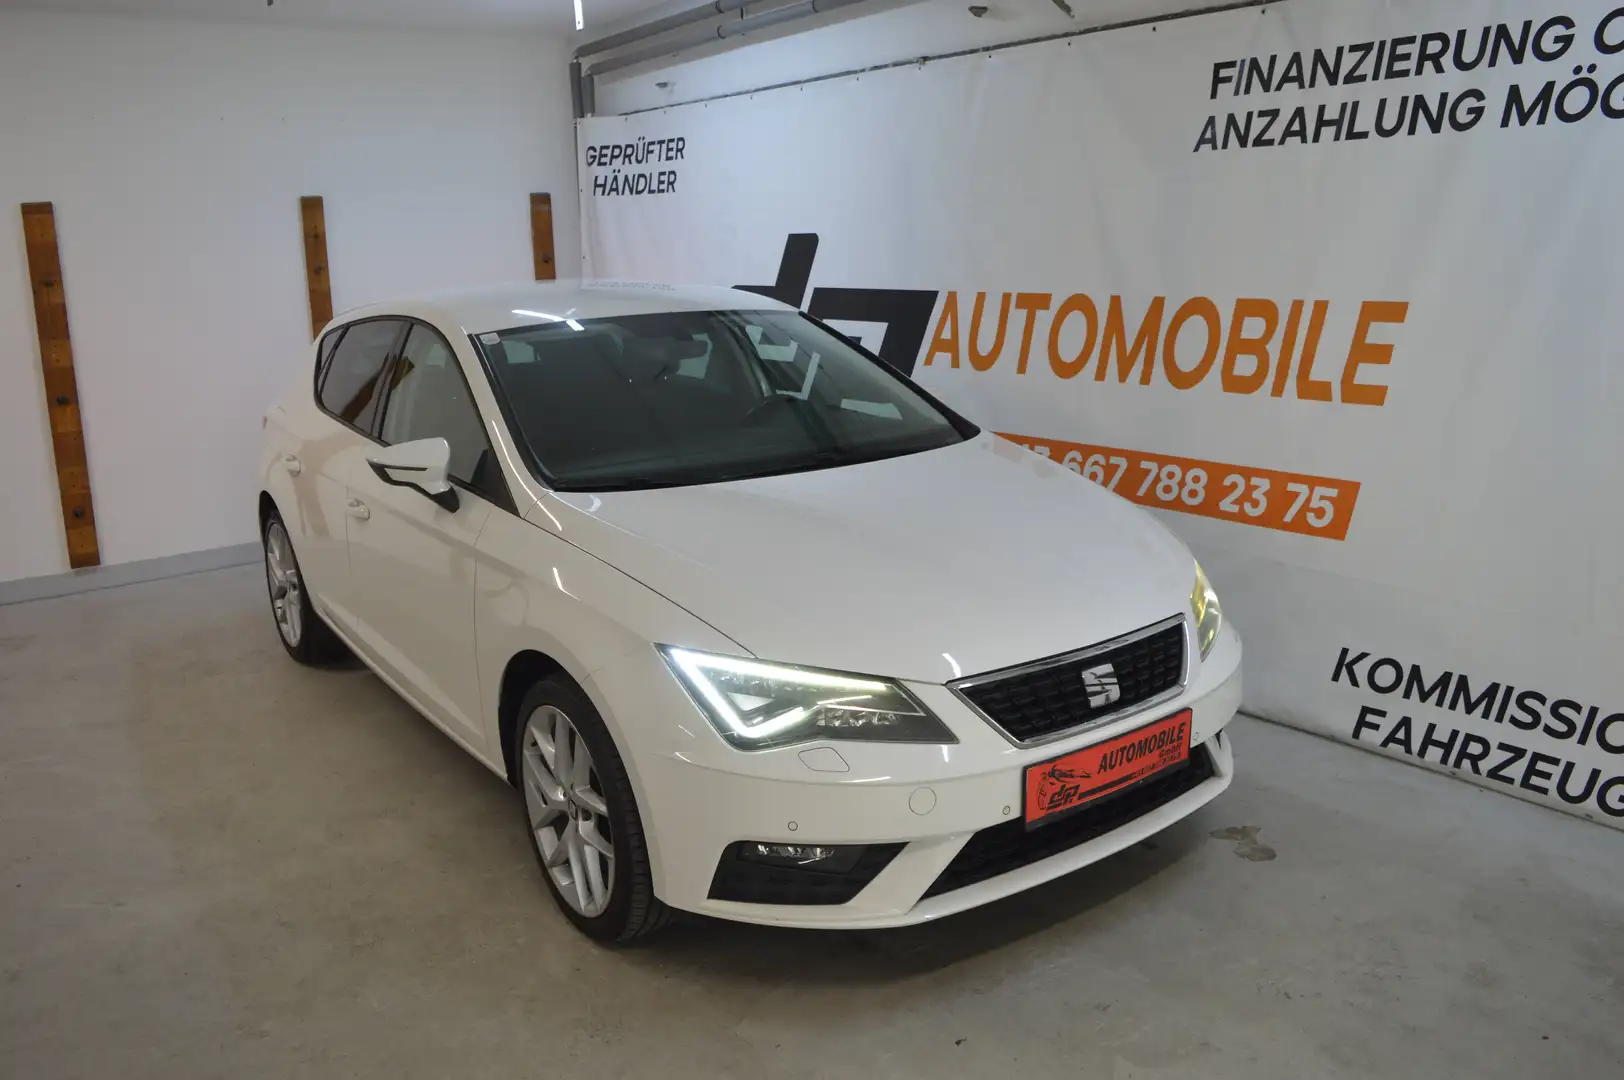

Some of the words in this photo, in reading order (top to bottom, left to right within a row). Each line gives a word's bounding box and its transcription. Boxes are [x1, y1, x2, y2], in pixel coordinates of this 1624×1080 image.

[1209, 15, 1576, 100] FINANZIERUNG
[586, 136, 686, 167] GEPRÜFTER
[1193, 88, 1486, 153] ANZAHLUNG
[593, 169, 677, 197] HÄNDLER
[923, 290, 1410, 406] AUTOMOBILE
[1136, 460, 1208, 506] 788
[1219, 474, 1271, 517] 23
[1282, 482, 1339, 528] 75
[1331, 647, 1624, 755] KOMMISSIO
[1097, 721, 1187, 775] AUTOMOBILE
[1351, 705, 1624, 817] FAHRZEUG
